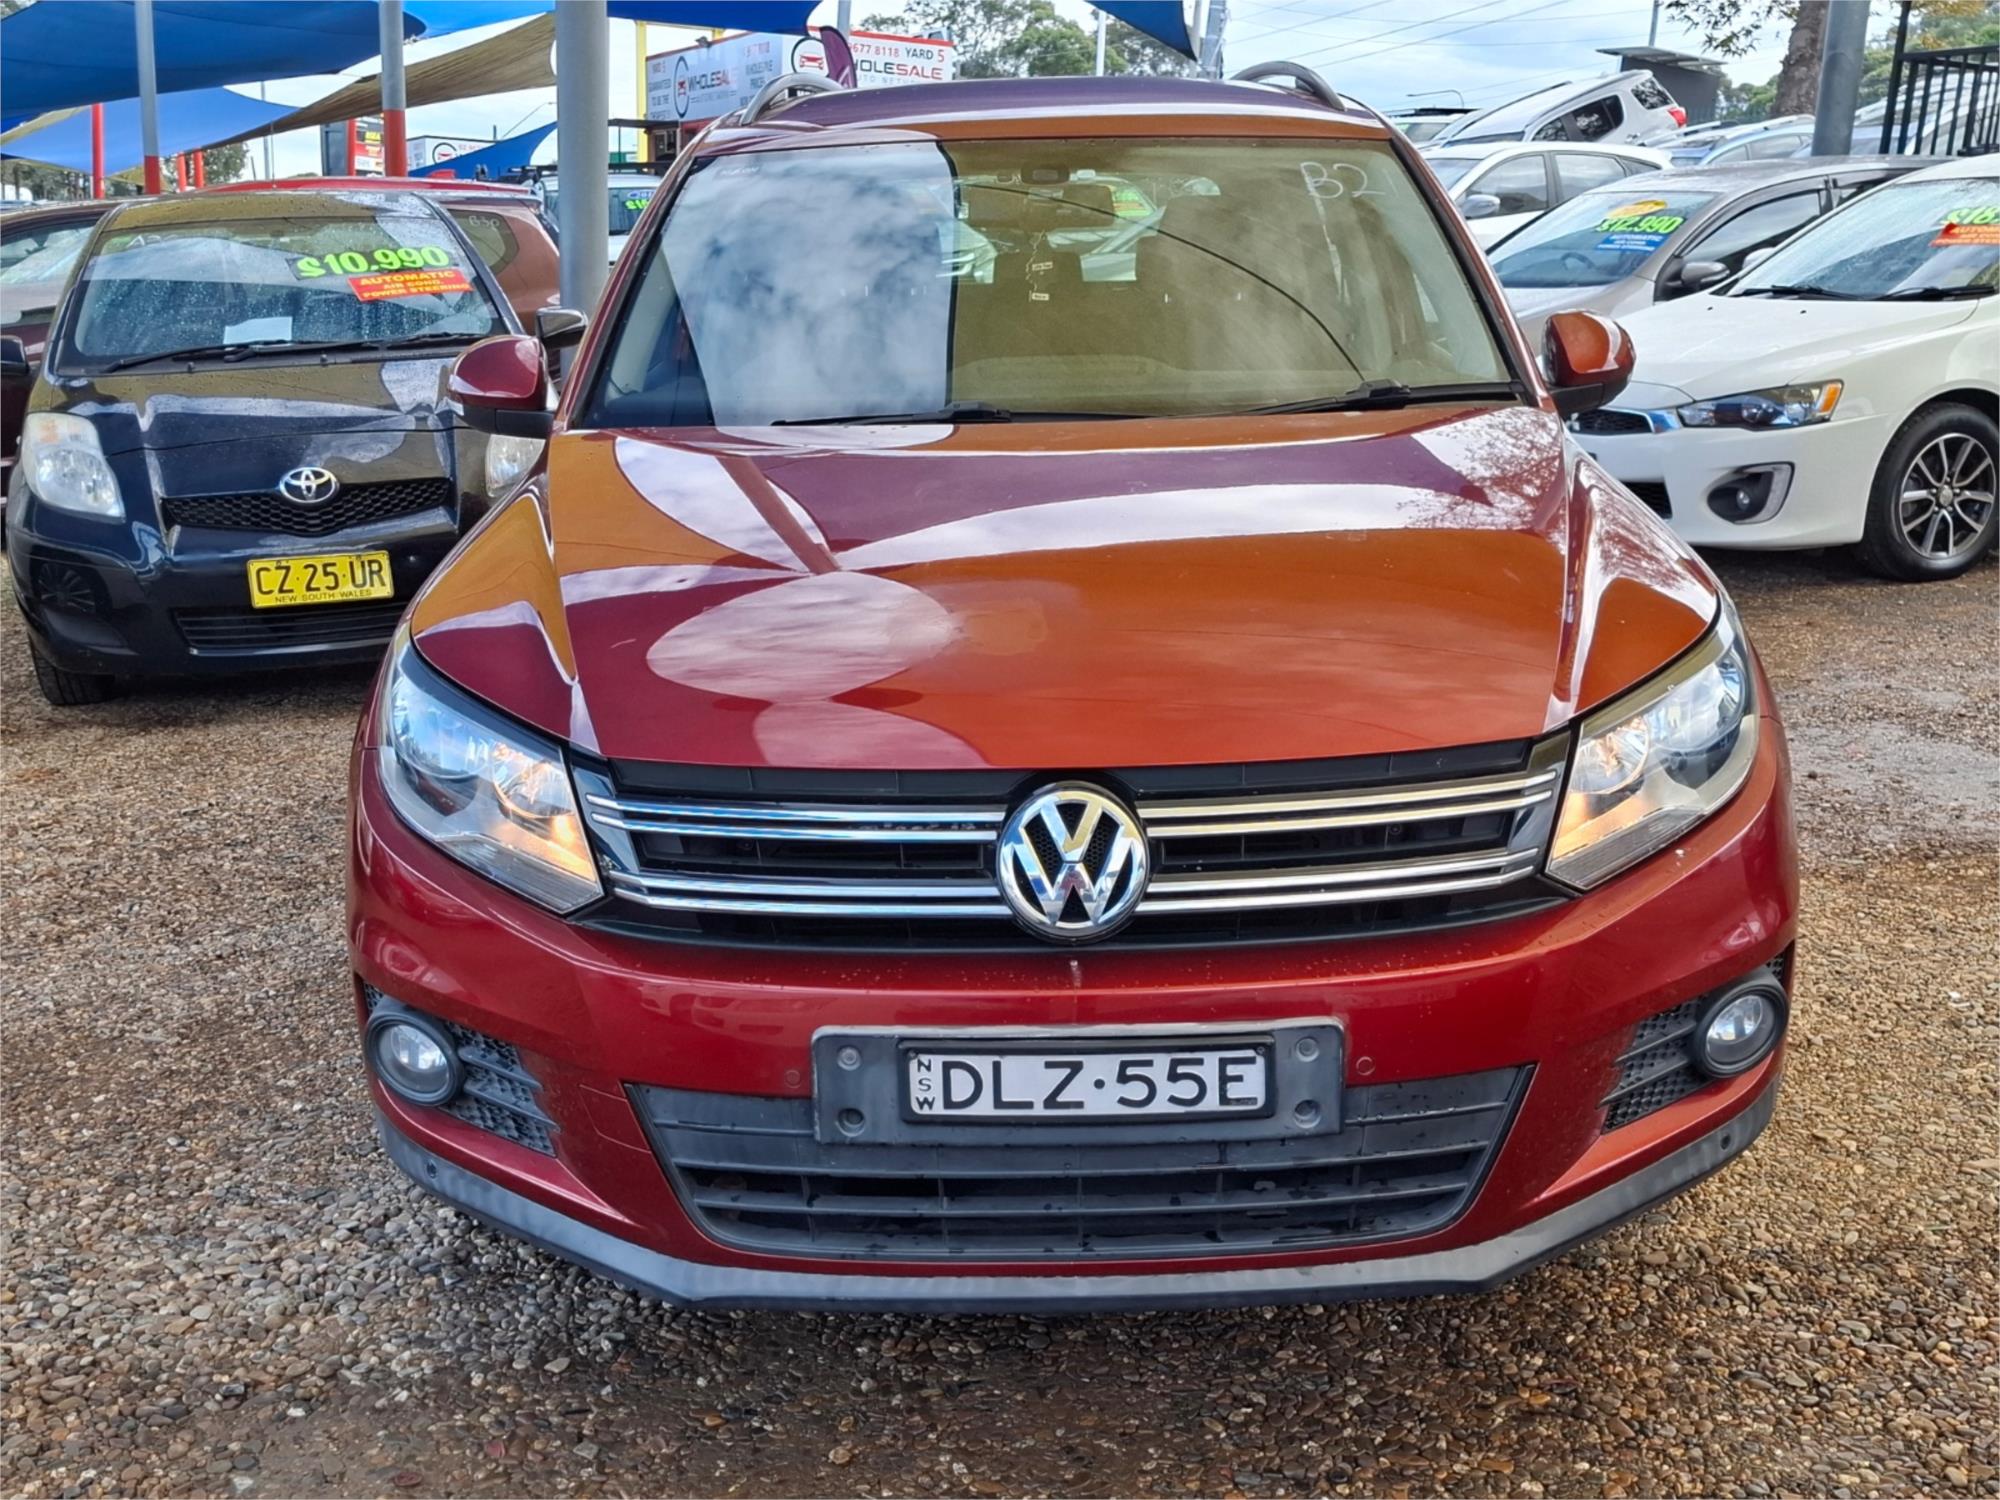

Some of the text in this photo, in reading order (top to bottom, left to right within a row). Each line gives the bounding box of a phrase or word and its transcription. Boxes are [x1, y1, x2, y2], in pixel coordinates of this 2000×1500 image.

[905, 48, 945, 63] YARD 5
[360, 270, 456, 285] AUTOMATIC
[362, 283, 471, 298] POWER STEERING
[302, 592, 335, 602] SOUTH
[340, 589, 372, 598] WALES
